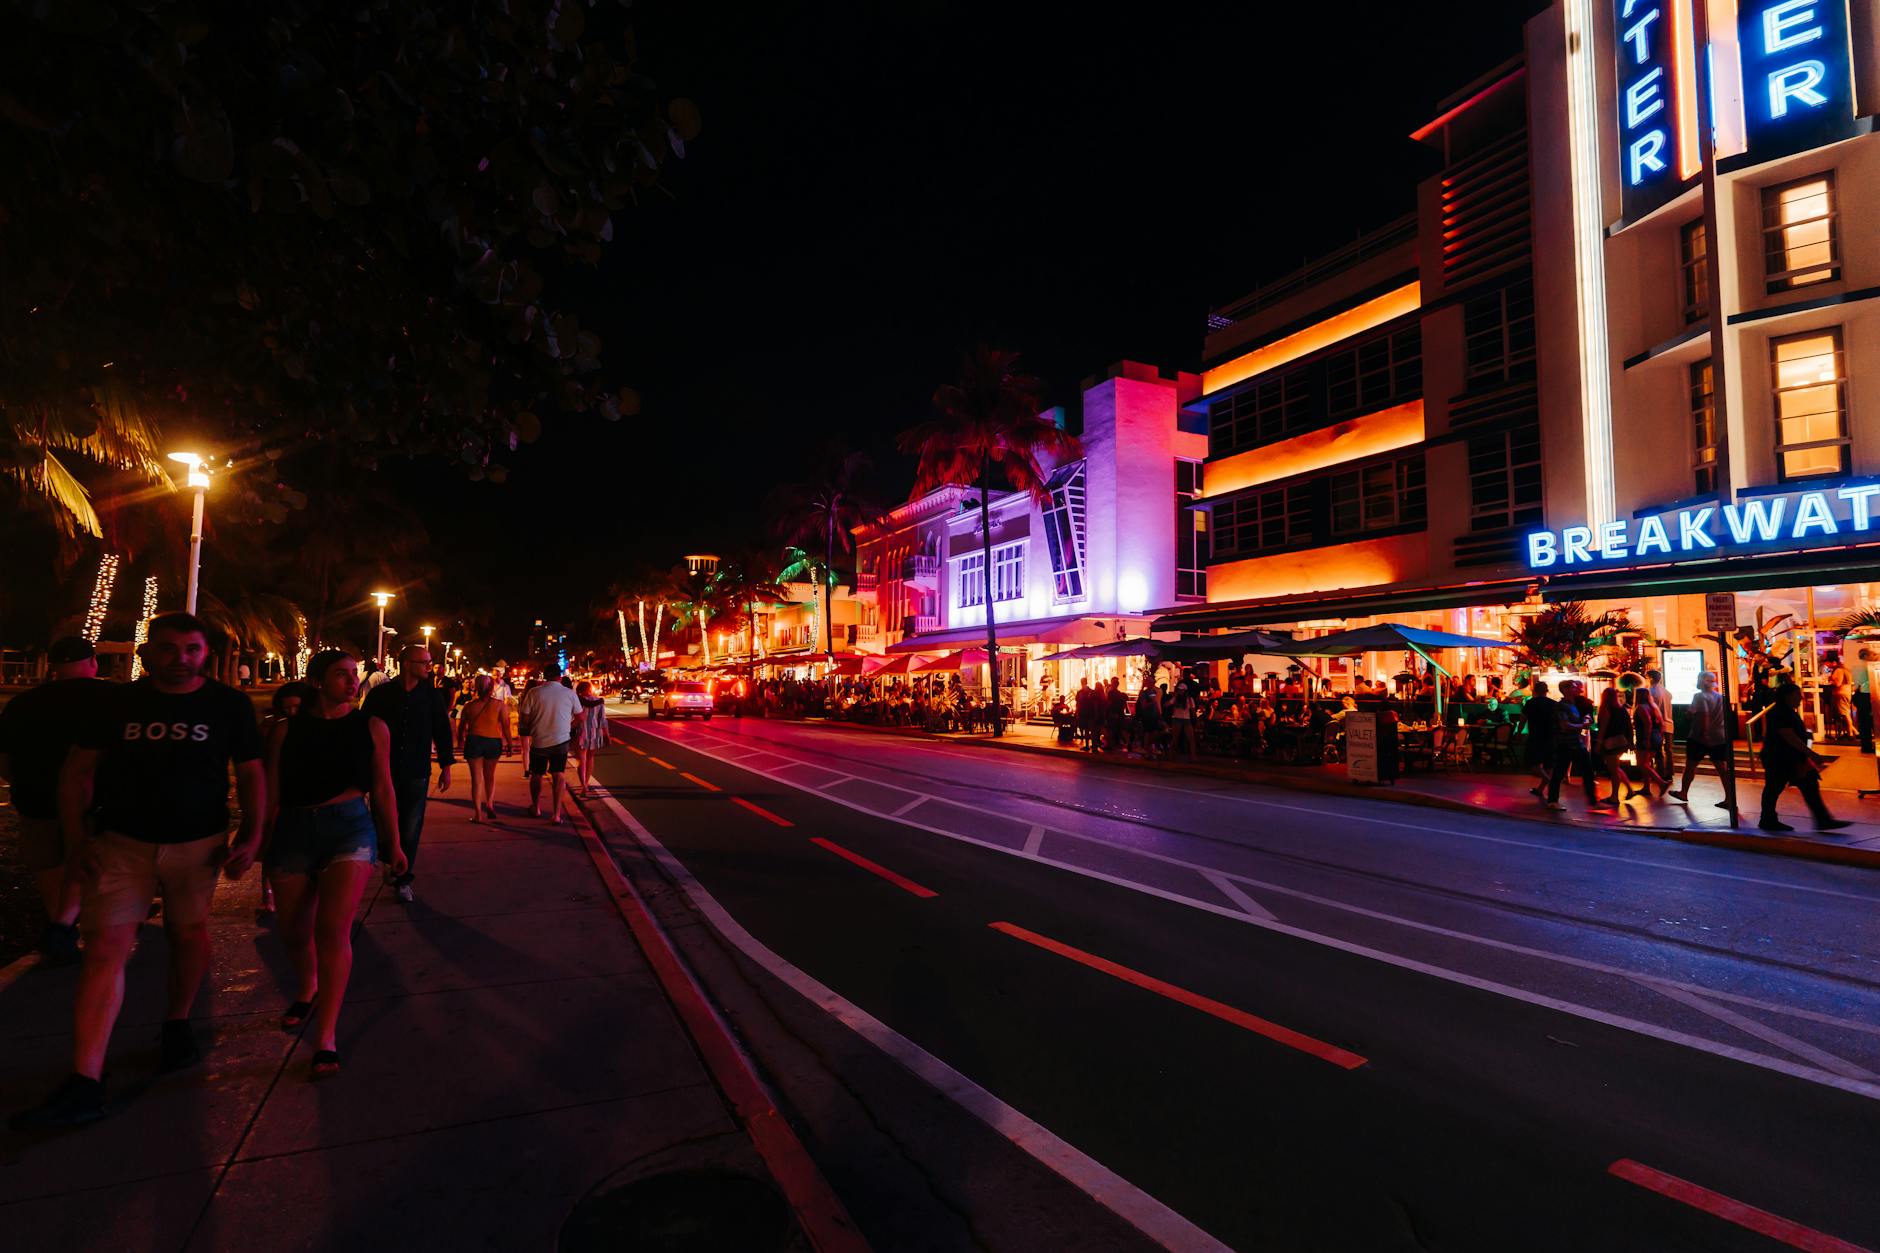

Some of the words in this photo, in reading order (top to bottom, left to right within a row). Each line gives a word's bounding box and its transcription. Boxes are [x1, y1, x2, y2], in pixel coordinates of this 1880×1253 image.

[1761, 0, 1829, 120] ER
[1526, 483, 1880, 569] BREAKWAT
[124, 721, 209, 742] BOSS
[1348, 728, 1373, 740] VALET
